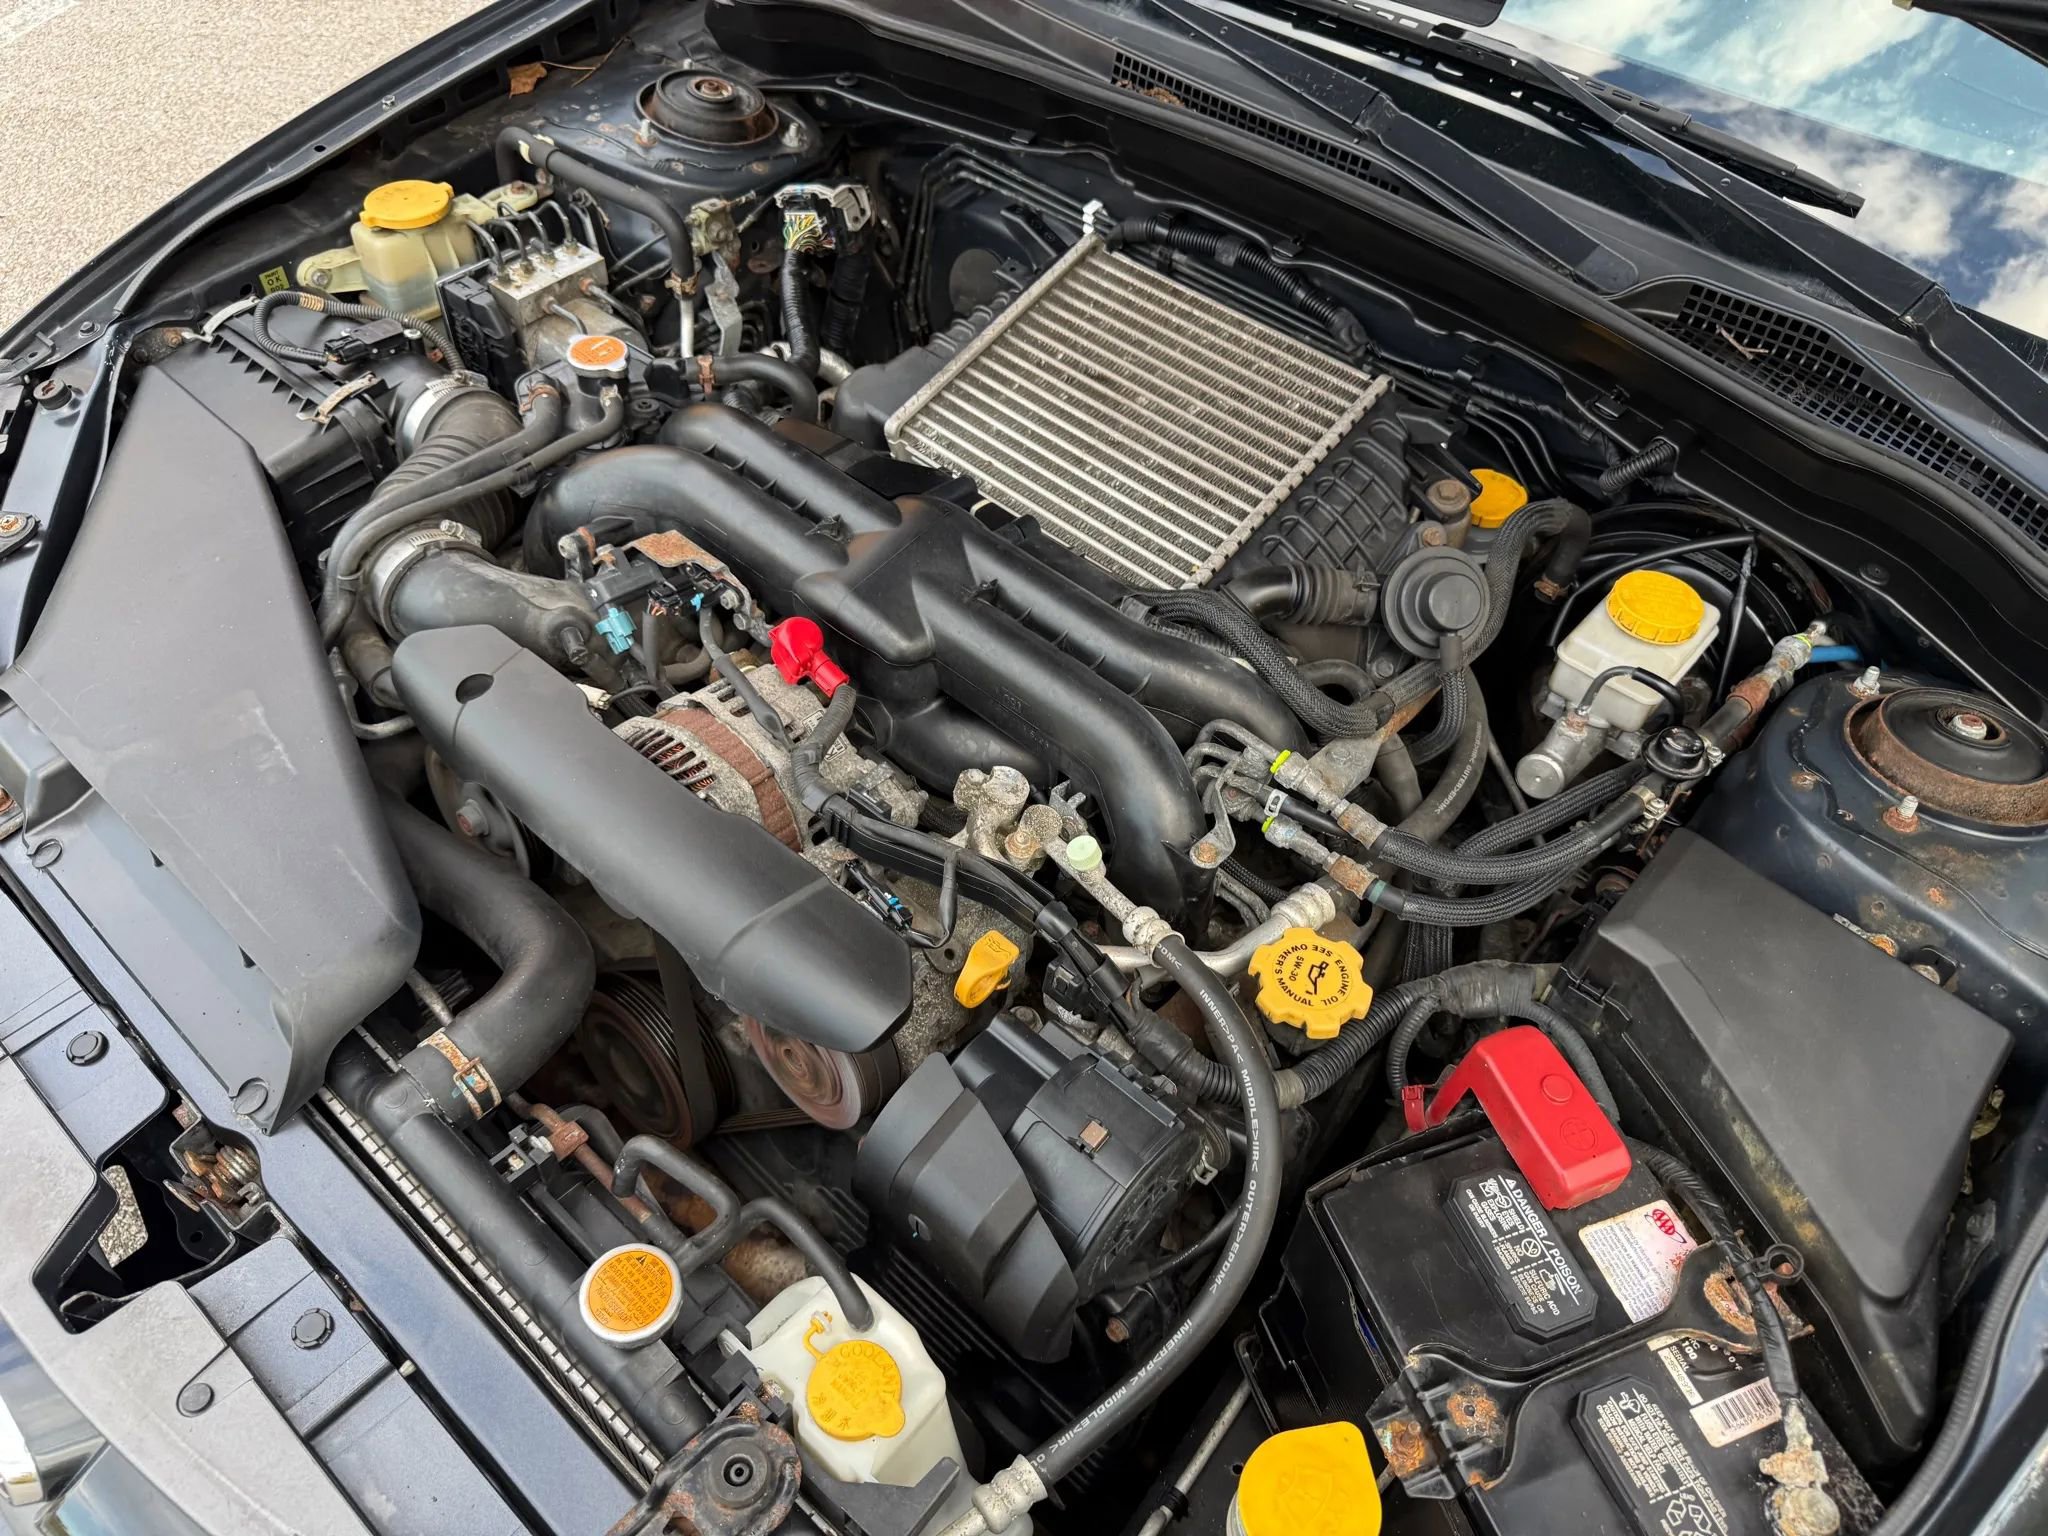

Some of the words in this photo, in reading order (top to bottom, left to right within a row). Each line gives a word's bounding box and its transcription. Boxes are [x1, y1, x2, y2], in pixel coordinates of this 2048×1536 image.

[1274, 944, 1308, 975] OWNER'S
[1312, 944, 1333, 957] SEE
[1289, 956, 1304, 982] 5W-30
[1335, 959, 1351, 996] ENGINE
[1277, 977, 1314, 1006] MANUAL
[1321, 995, 1338, 1006] OIL
[1199, 989, 1244, 1063] INNER>PA<
[1240, 1069, 1258, 1172] MIDDLE>IIR<
[1479, 1200, 1496, 1222] GASES
[1486, 1197, 1510, 1231] EXPLOSIVE
[1501, 1209, 1515, 1227] EYES
[1507, 1207, 1524, 1230] SHIELD
[1652, 1212, 1673, 1233] AAA
[1208, 1180, 1255, 1294] OUTER>EPDM<
[1511, 1187, 1548, 1238] DANGER
[1548, 1247, 1583, 1295] POISON
[1513, 1244, 1524, 1257] NO
[1517, 1273, 1538, 1303] BLINDNESS
[1523, 1271, 1532, 1283] CAN
[1529, 1283, 1545, 1303] CAUSE
[1528, 1268, 1551, 1300] SULFURIC
[1546, 1299, 1560, 1316] ACID
[1129, 1318, 1193, 1385] INNER>PA<
[1669, 1344, 1689, 1371] SERIAL
[1680, 1340, 1698, 1360] 100
[1048, 1385, 1127, 1453] MIDDLE>IIR<
[1661, 1418, 1672, 1432] OUT
